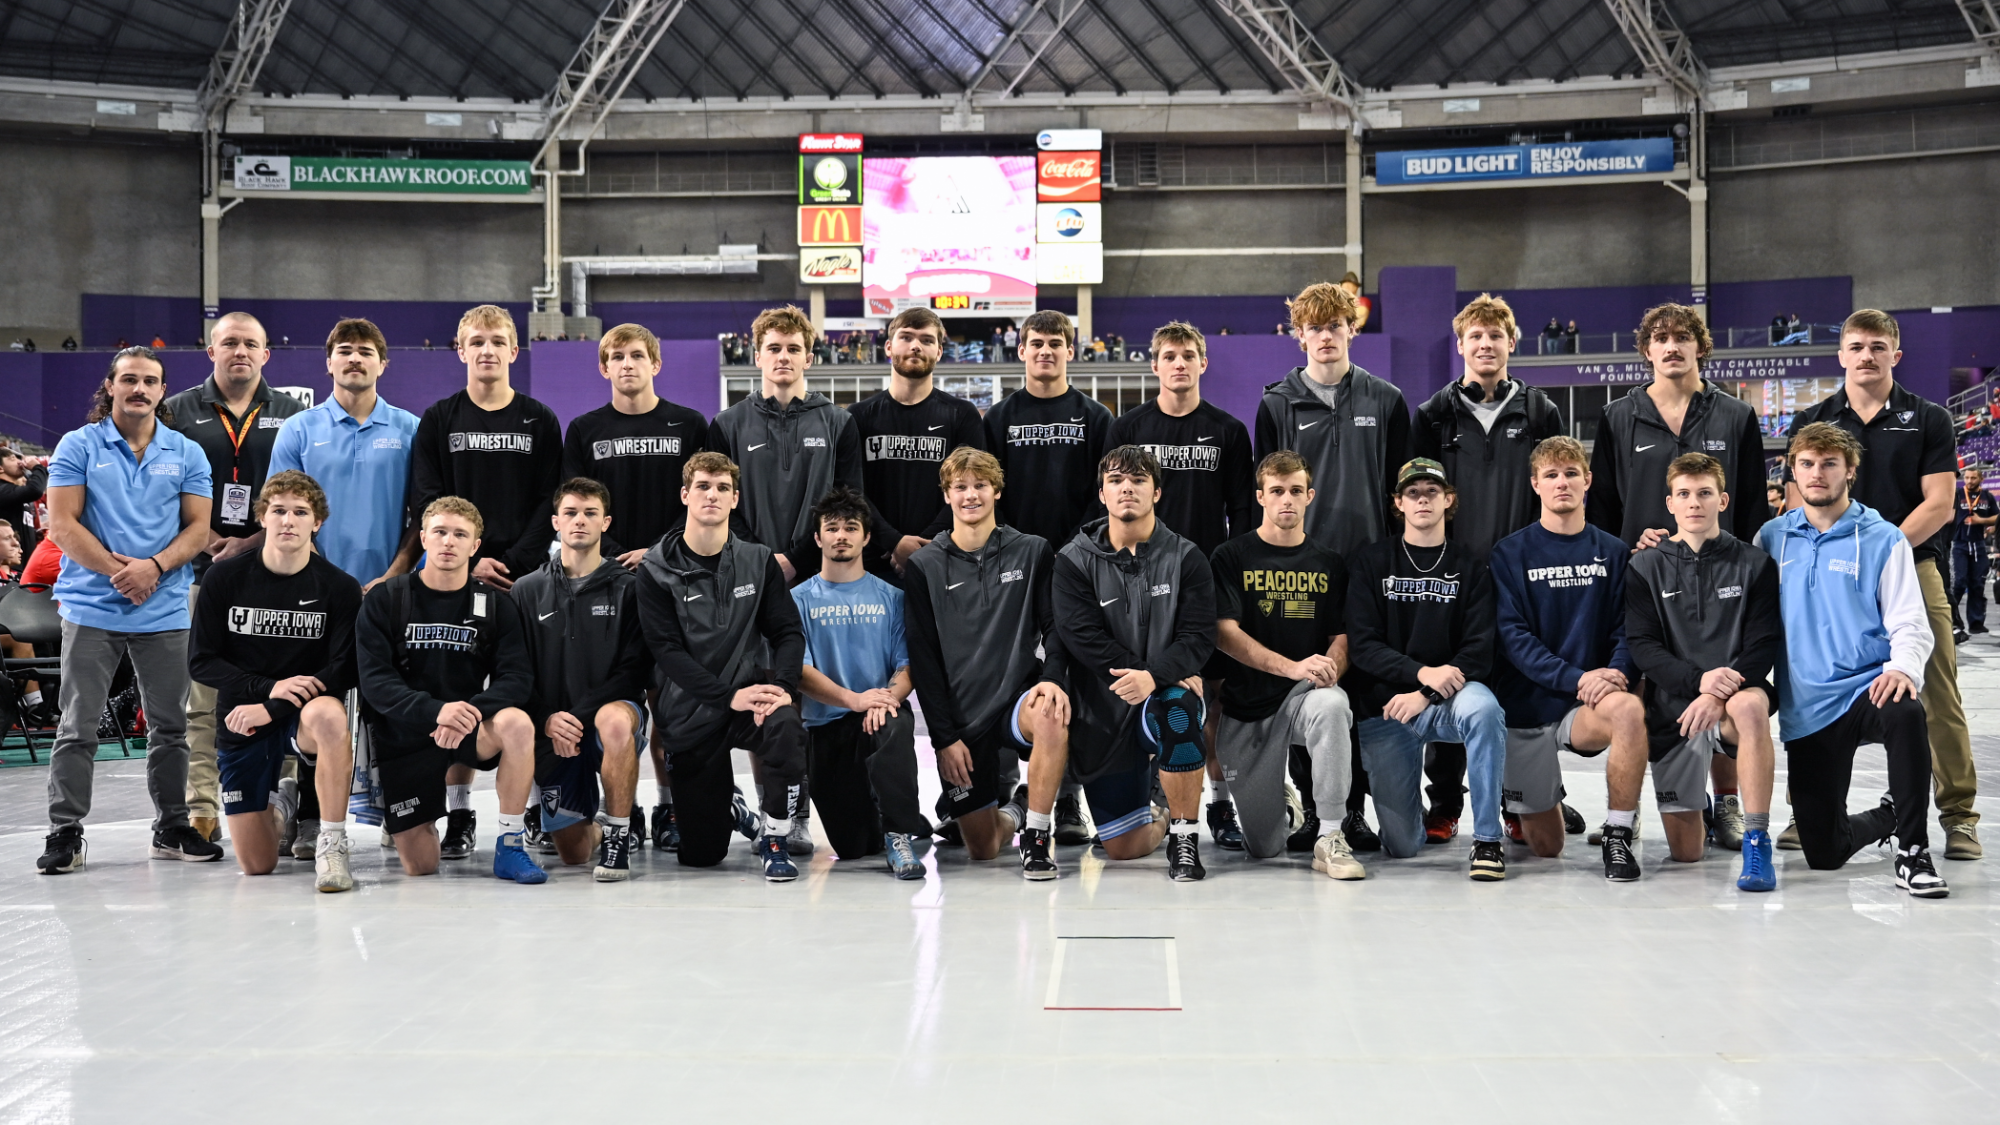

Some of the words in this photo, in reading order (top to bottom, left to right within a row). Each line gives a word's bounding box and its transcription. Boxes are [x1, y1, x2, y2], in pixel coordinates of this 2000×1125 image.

[1530, 146, 1582, 161] ENJOY
[1406, 157, 1451, 176] BUD
[1454, 154, 1519, 173] LIGHT
[1530, 155, 1646, 174] RESPONSIBLY
[294, 165, 528, 186] BLACKHAWKROOF.COM
[1577, 366, 1600, 374] VAN
[1728, 358, 1810, 369] CHARITABLE
[1600, 373, 1651, 382] FOUNDA
[1750, 368, 1786, 377] ROOM
[1025, 426, 1055, 438] UPPER
[1058, 426, 1085, 438] IOWA
[468, 434, 532, 452] WRESTLING
[614, 438, 680, 455] WRESTLING
[888, 437, 915, 451] UPPER
[917, 438, 942, 453] IOWA
[888, 450, 941, 460] WRESTLING
[1161, 446, 1189, 460] UPPER
[1191, 447, 1217, 462] IOWA
[1161, 459, 1215, 470] WRESTLING
[1527, 565, 1574, 582] UPPER
[1575, 563, 1608, 577] IOWA
[1243, 570, 1329, 594] PEACOCKS
[1395, 580, 1426, 593] UPPER
[1429, 580, 1456, 595] IOWA
[1548, 577, 1594, 588] WRESTLING
[1265, 591, 1309, 601] WRESTLING
[810, 604, 850, 619] UPPER
[852, 604, 887, 616] IOWA
[255, 610, 290, 627] UPPER
[292, 612, 322, 629] IOWA
[820, 616, 877, 626] WRESTLING
[254, 625, 320, 637] WRESTLING
